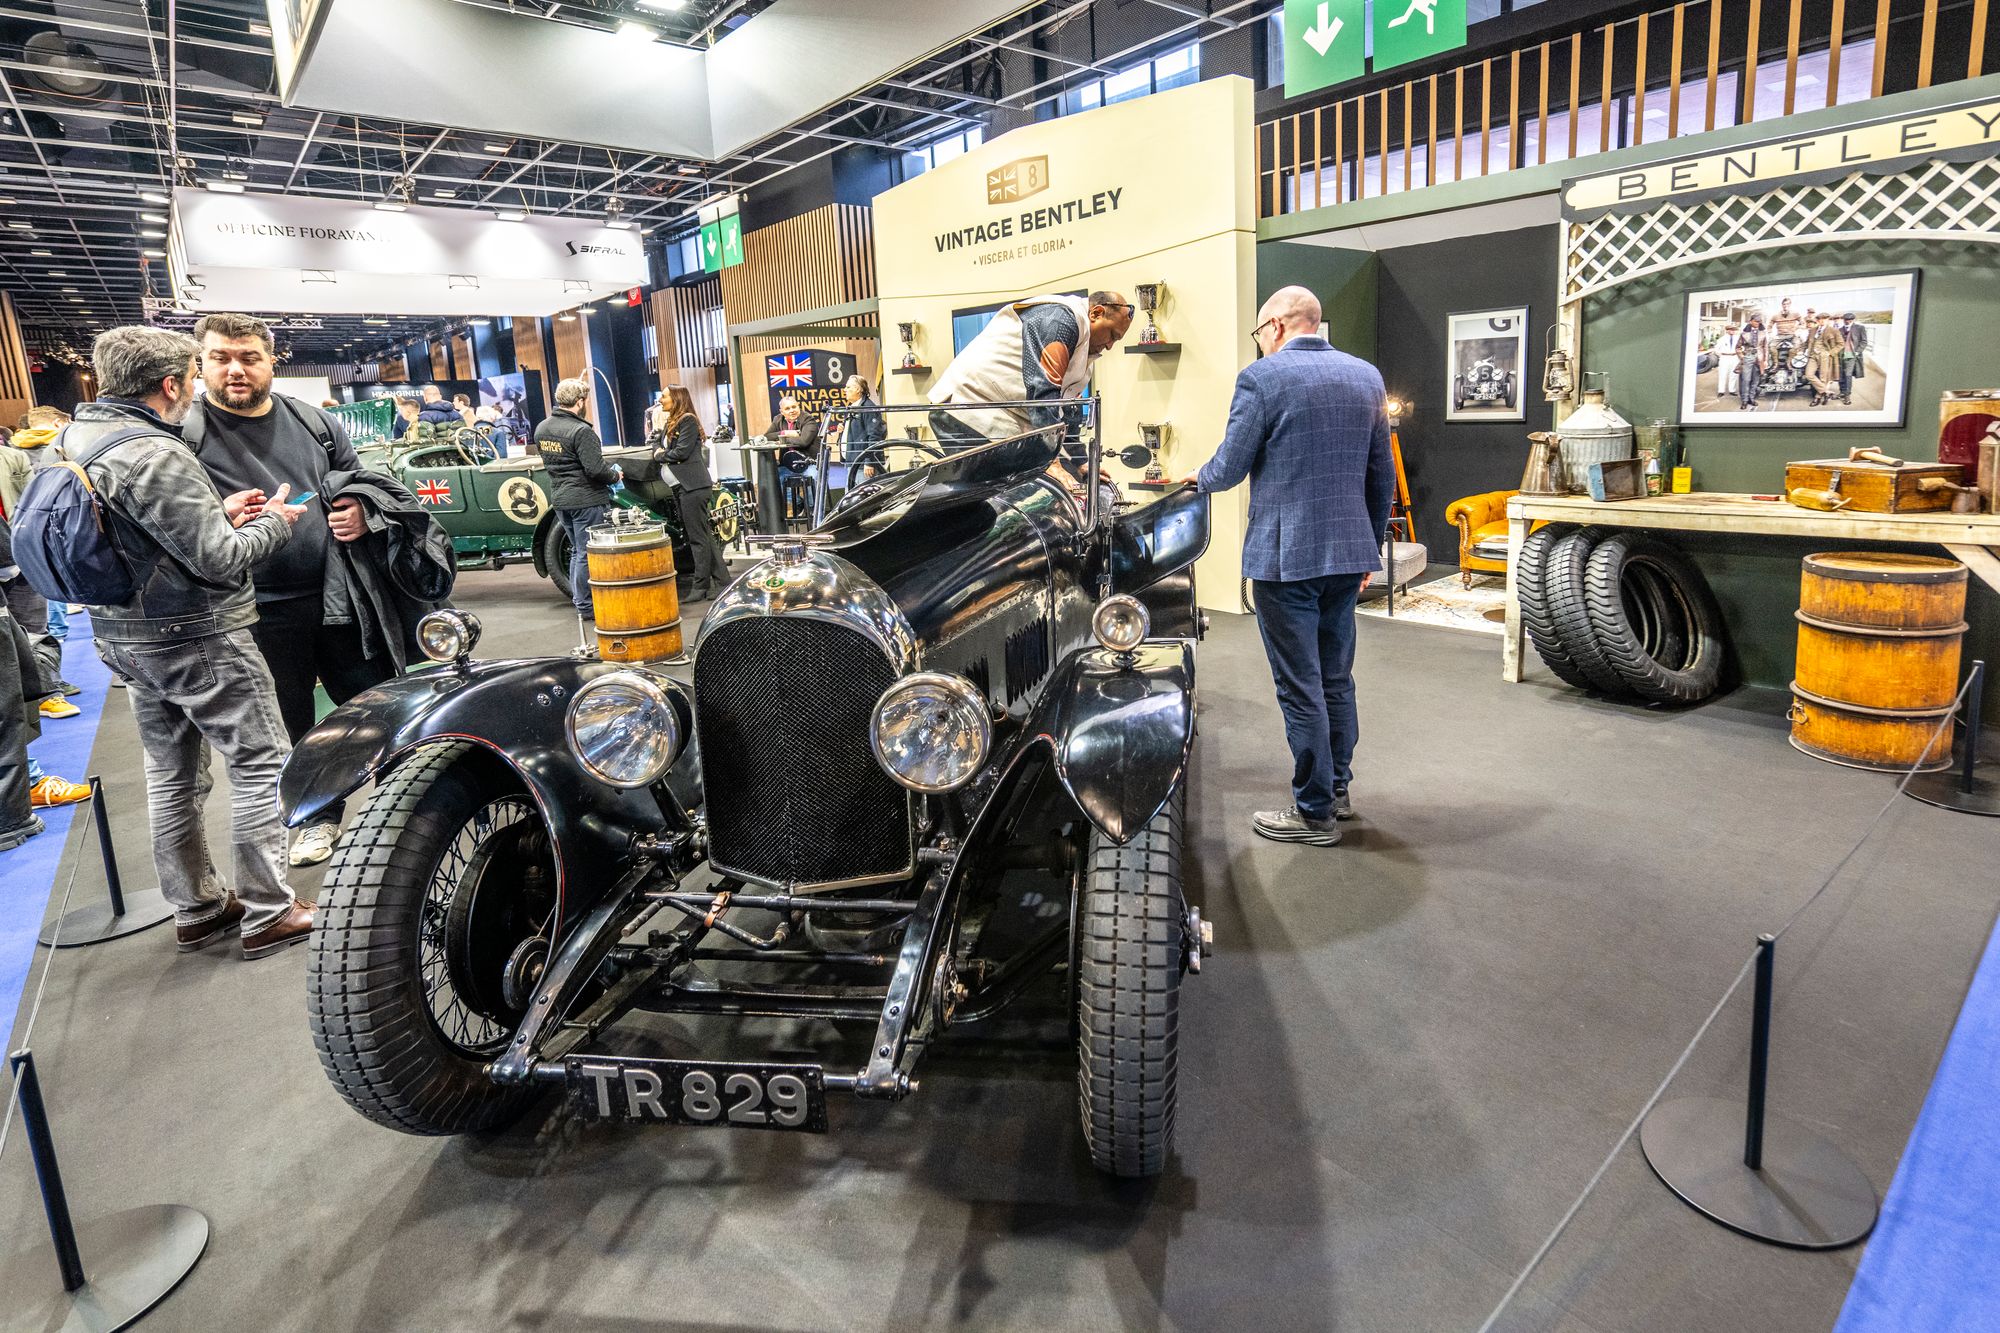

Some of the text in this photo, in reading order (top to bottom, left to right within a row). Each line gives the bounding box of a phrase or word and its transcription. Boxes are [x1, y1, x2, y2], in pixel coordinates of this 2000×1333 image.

[1617, 111, 2000, 200] BENTLEY
[1028, 163, 1038, 188] 8
[934, 187, 1123, 253] VINTAGE BENTLEY
[580, 245, 626, 255] SIFRAL
[978, 238, 1066, 266] VISCERA ET GLORIA
[827, 356, 843, 384] 8
[1481, 367, 1490, 380] 5
[508, 482, 539, 520] 8
[582, 1064, 808, 1127] TR 829
